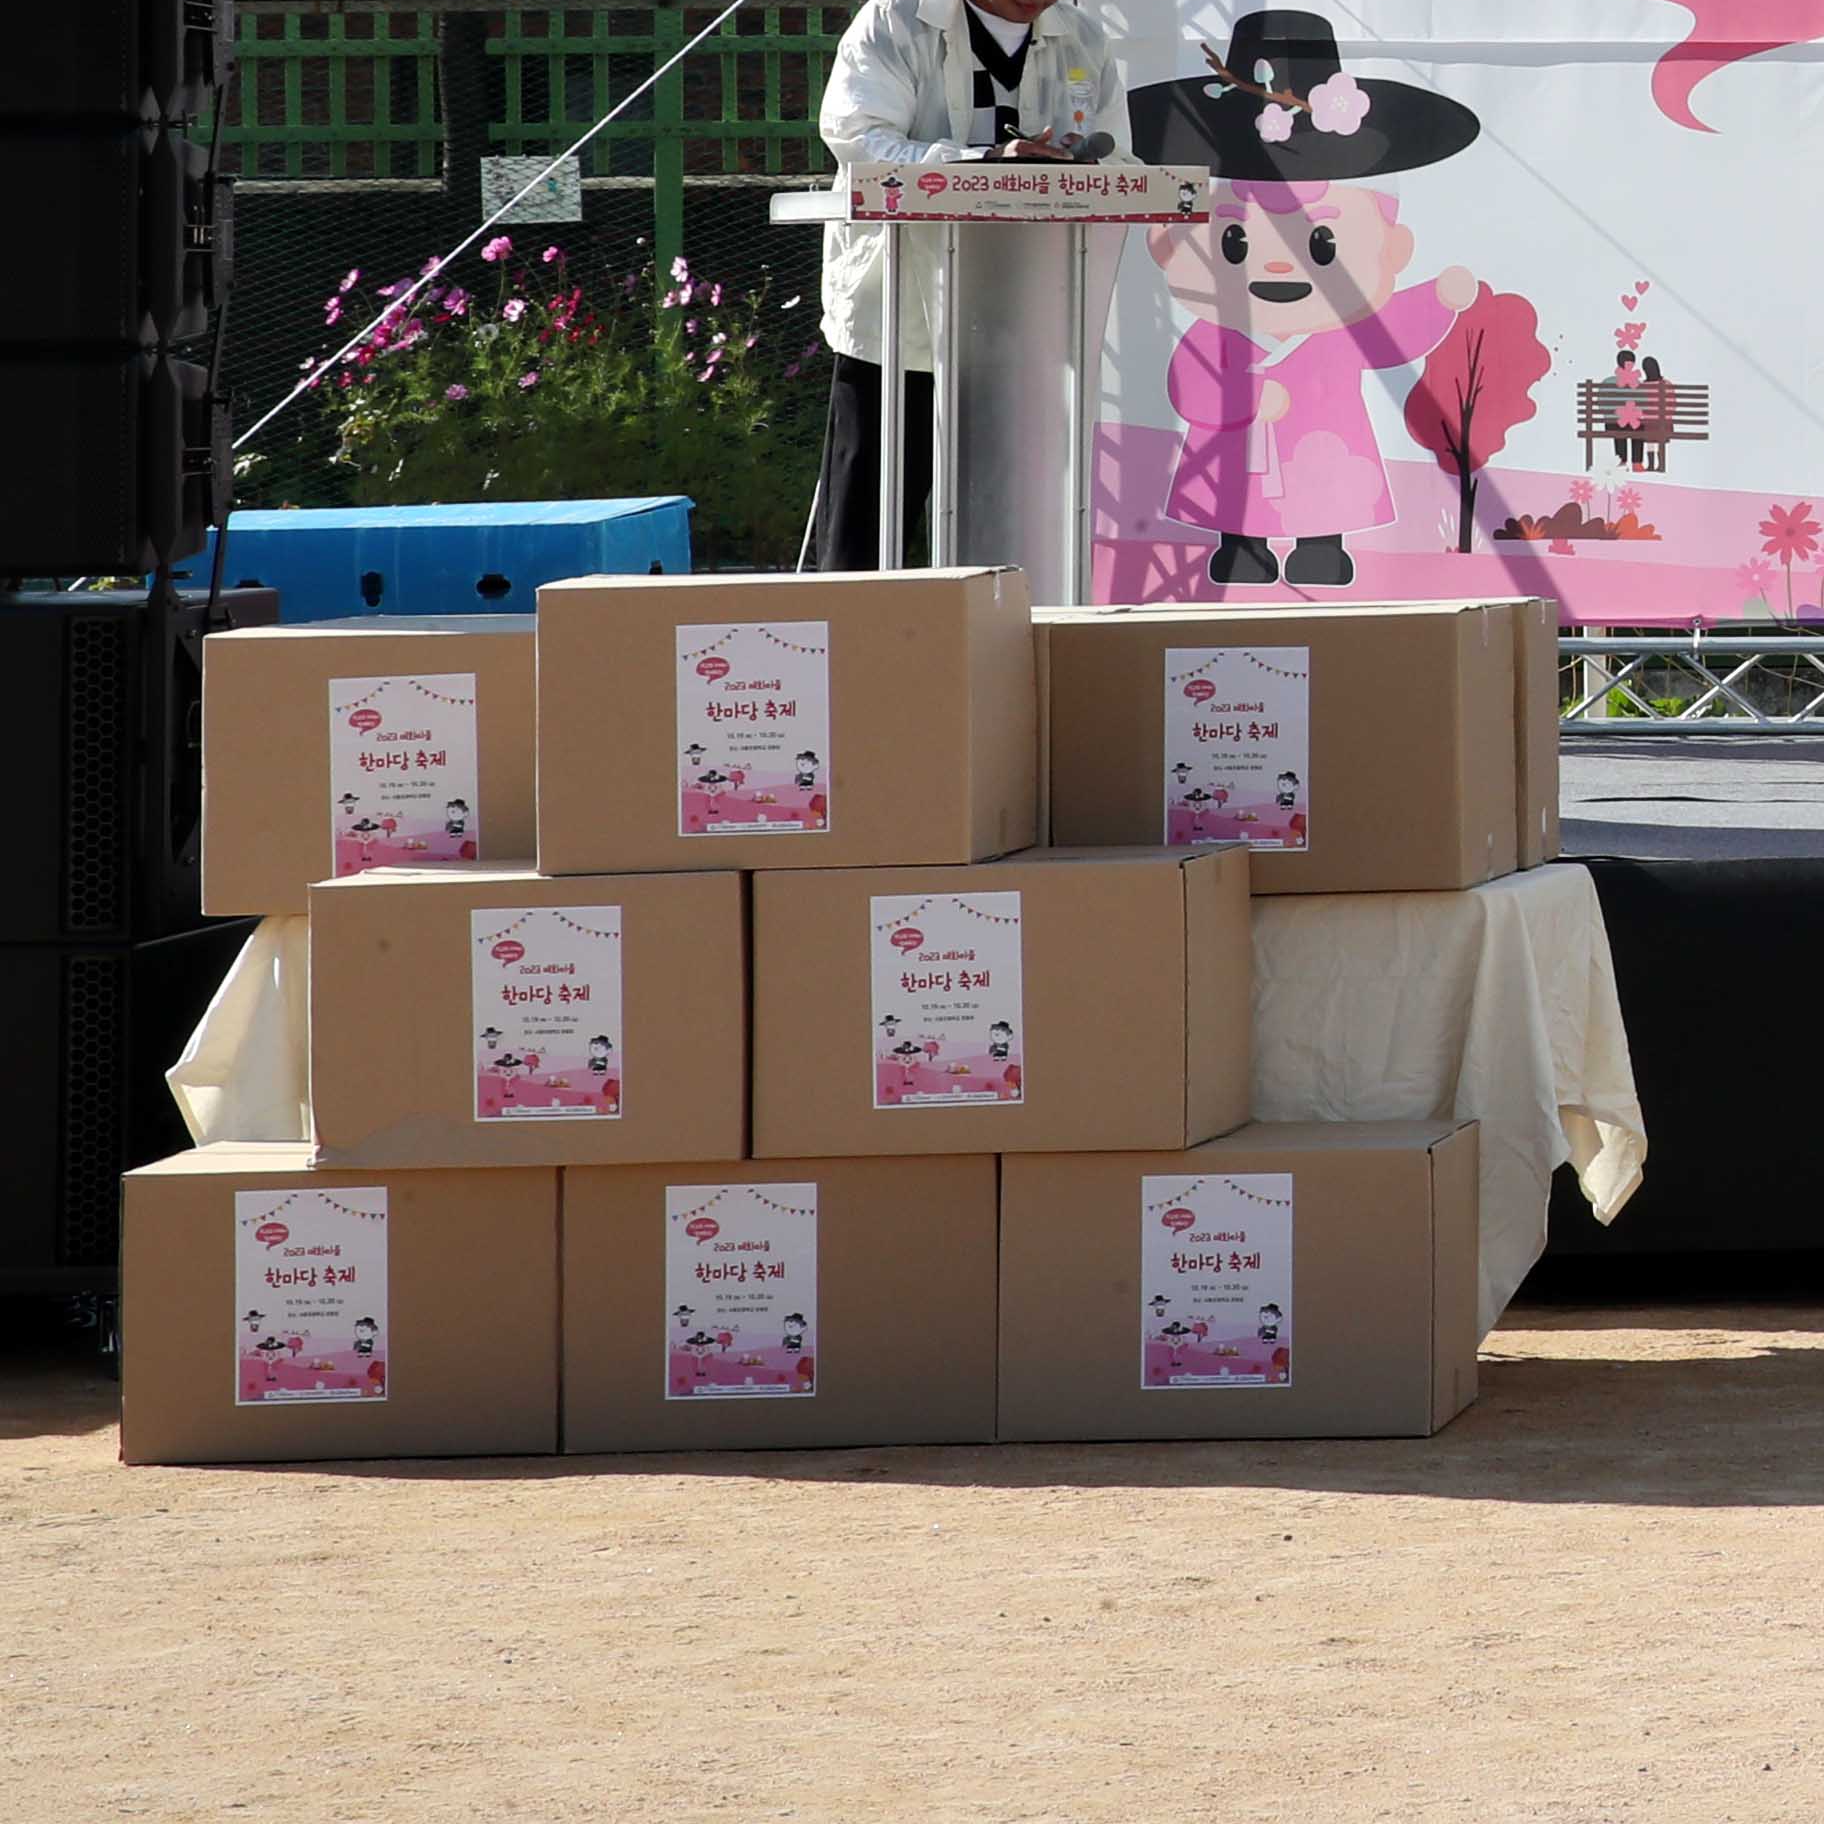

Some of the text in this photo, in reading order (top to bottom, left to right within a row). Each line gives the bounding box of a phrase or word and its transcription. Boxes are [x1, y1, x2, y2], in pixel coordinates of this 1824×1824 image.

[951, 175, 990, 192] 2023
[1058, 174, 1110, 196] 한마당
[1116, 174, 1148, 196] 축제
[706, 699, 796, 722] 한마당 축제
[1192, 721, 1279, 742] 한마당 축제
[359, 750, 446, 772] 한마당 축제
[900, 970, 990, 993] 한마당 축제
[501, 984, 590, 1005] 한마당 축제
[695, 1261, 785, 1283] 한마당 축제
[1171, 1251, 1261, 1273] 한마당 축제
[264, 1265, 355, 1288] 한마당 축제
